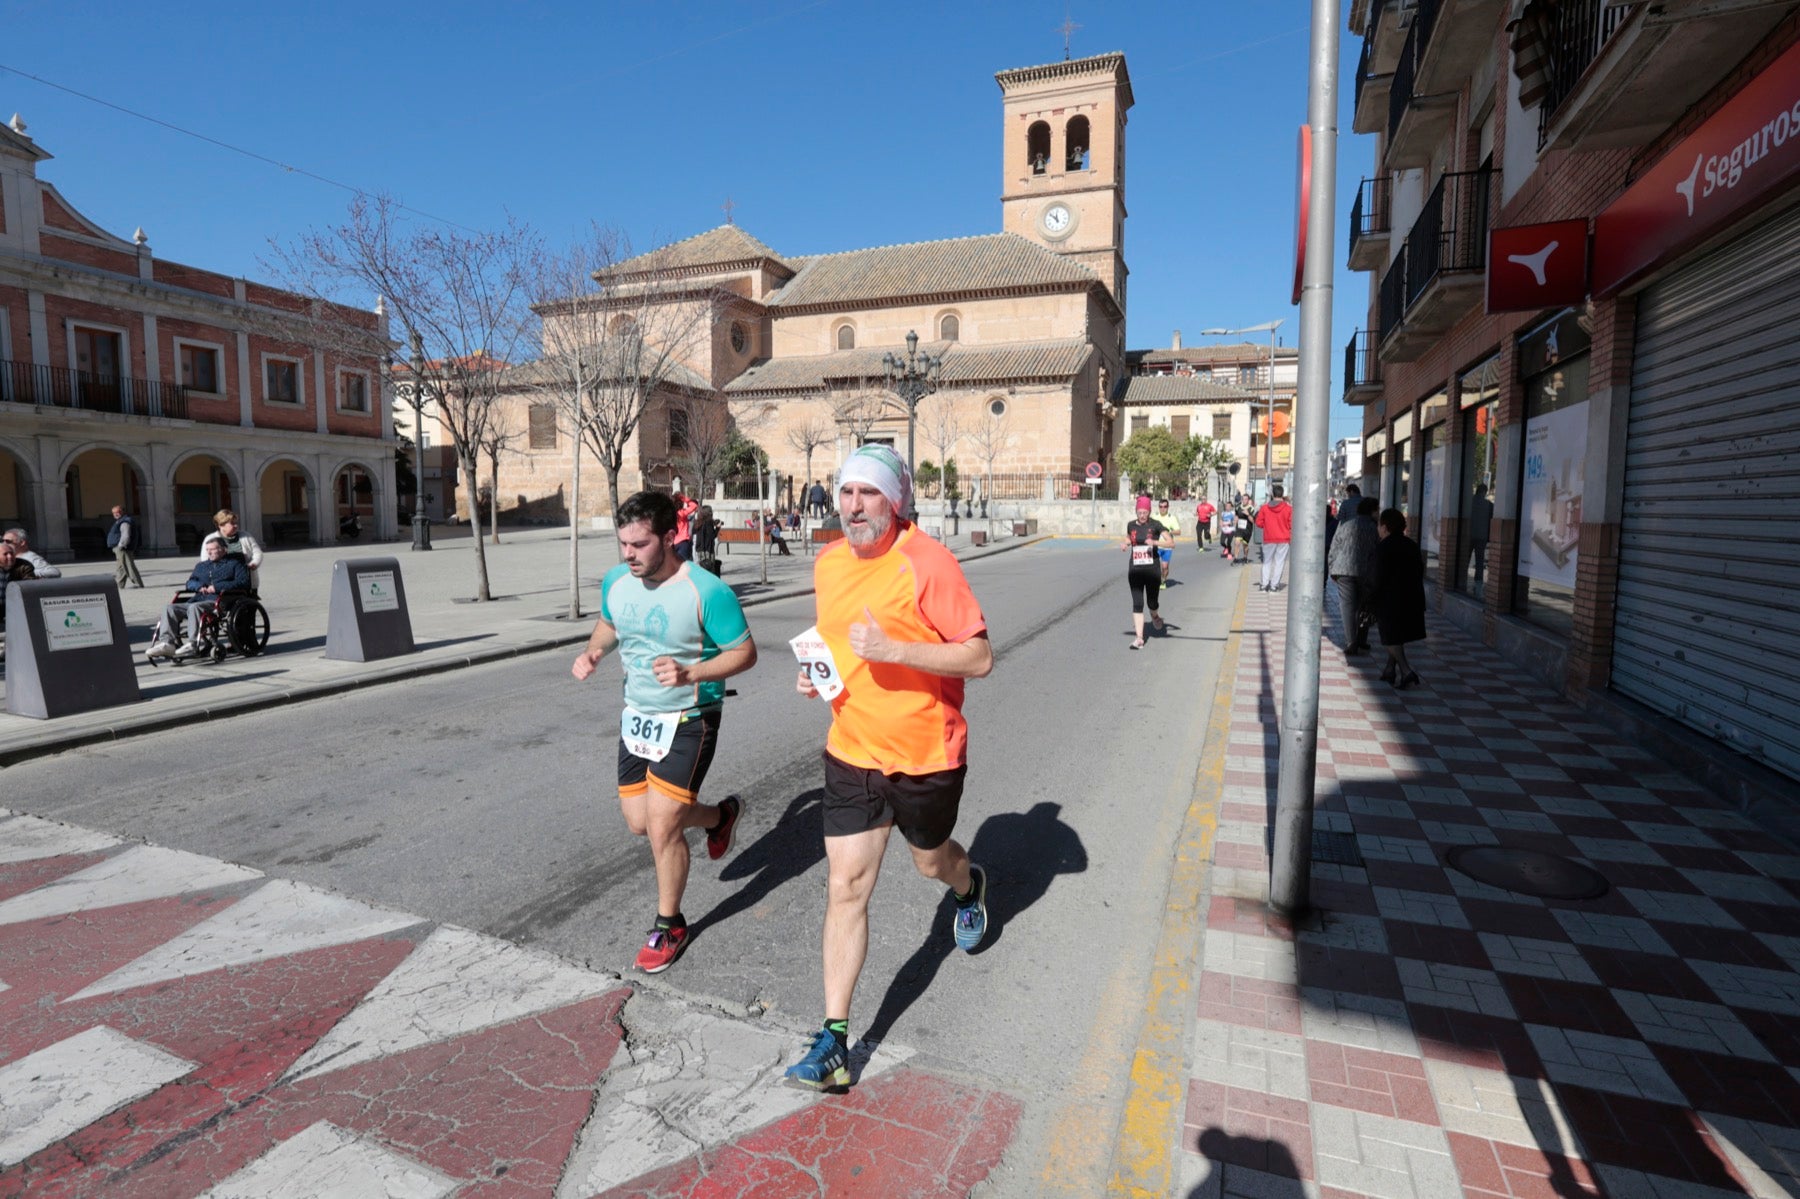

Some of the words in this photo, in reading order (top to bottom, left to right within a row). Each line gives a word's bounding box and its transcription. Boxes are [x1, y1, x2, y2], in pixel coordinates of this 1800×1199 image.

[1703, 99, 1800, 198] Seguros
[800, 661, 831, 680] 79
[631, 716, 664, 742] 361
